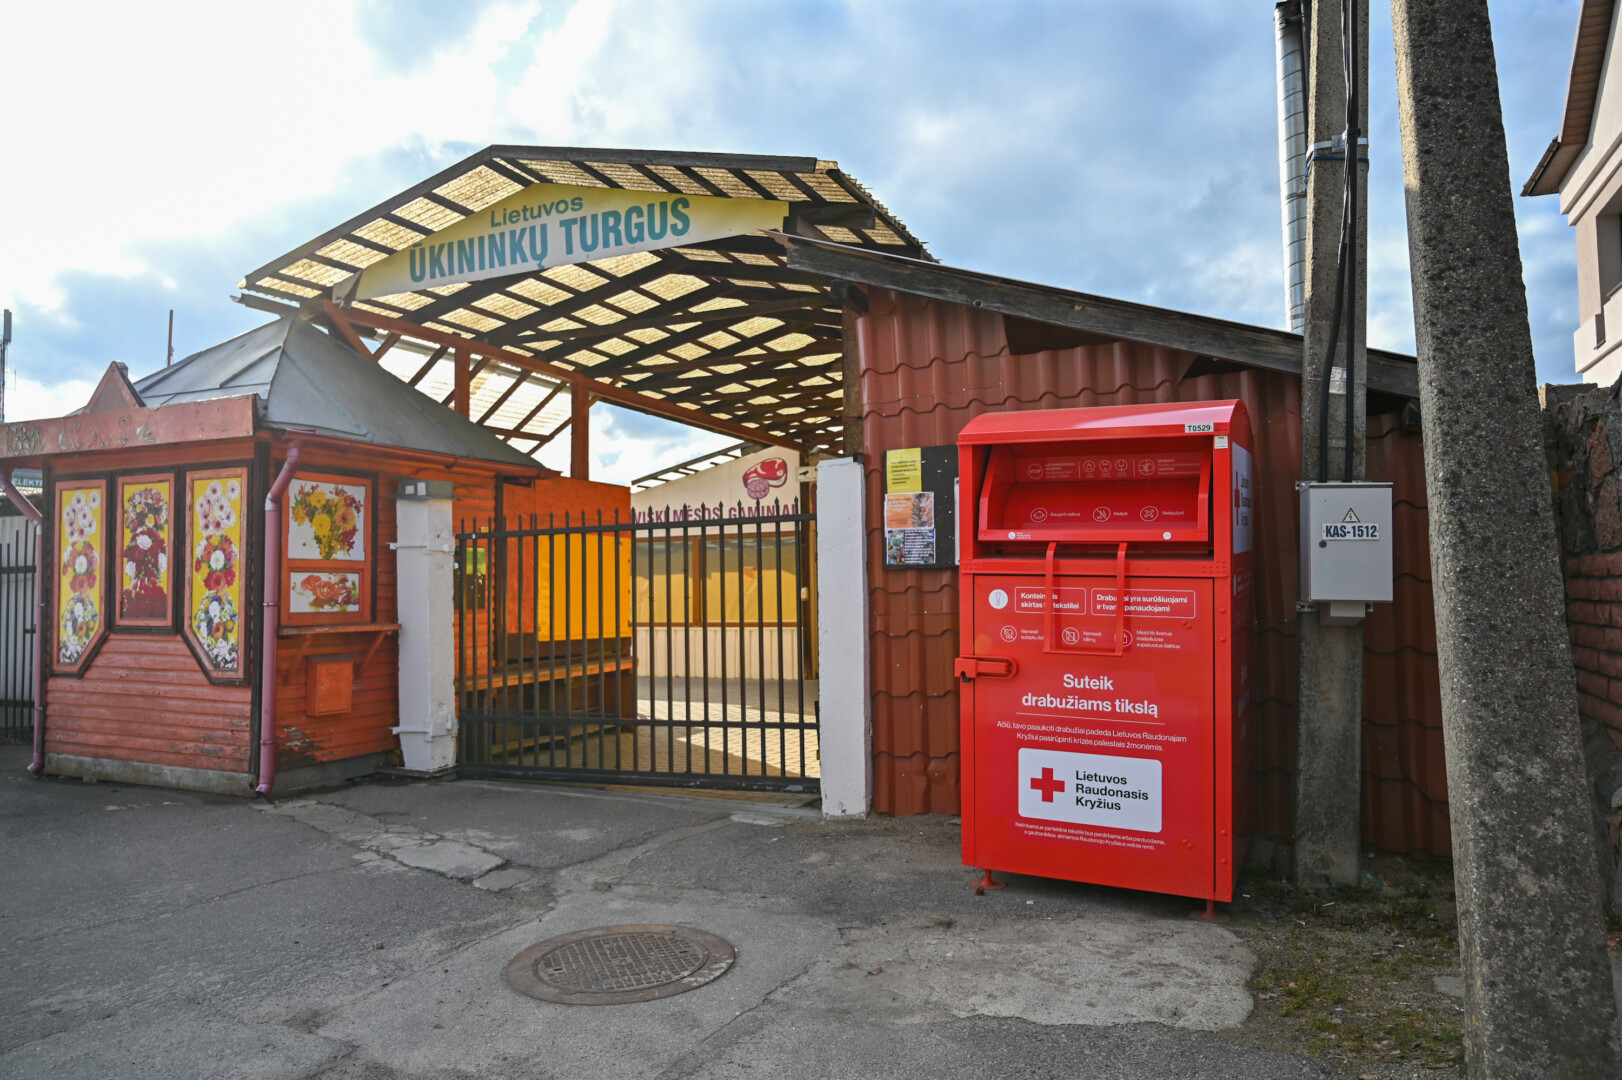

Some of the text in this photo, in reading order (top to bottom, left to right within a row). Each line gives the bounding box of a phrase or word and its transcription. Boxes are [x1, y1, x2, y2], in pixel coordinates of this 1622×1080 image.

[491, 196, 584, 228] Lietuvos
[409, 196, 691, 283] ŪKININKŲ TURGUS
[1187, 424, 1211, 432] T0529
[729, 504, 797, 519] GAMINAI
[1325, 525, 1378, 538] KAS-1512
[1021, 592, 1058, 600] Konteinis
[1096, 594, 1129, 602] Drabuai
[1142, 596, 1188, 604] surūšiuojami
[1053, 602, 1080, 610] tekstilei
[1063, 674, 1114, 690] Suteik
[1022, 692, 1158, 718] drabužiams tikslą
[1027, 724, 1054, 732] paaukoti
[1055, 726, 1085, 734] drabužiai
[1086, 728, 1111, 736] padeda
[1112, 730, 1142, 739] Lietuvos
[1143, 732, 1187, 742] Raudonajam
[1016, 732, 1038, 740] Kryžiui
[1039, 735, 1072, 744] pasirūpinti
[1094, 739, 1126, 748] paliestais
[1126, 742, 1164, 751] žmonėmis.
[1076, 770, 1127, 785] Lietuvos
[1076, 783, 1149, 800] Raudonasis
[1076, 796, 1122, 810] Kryžius
